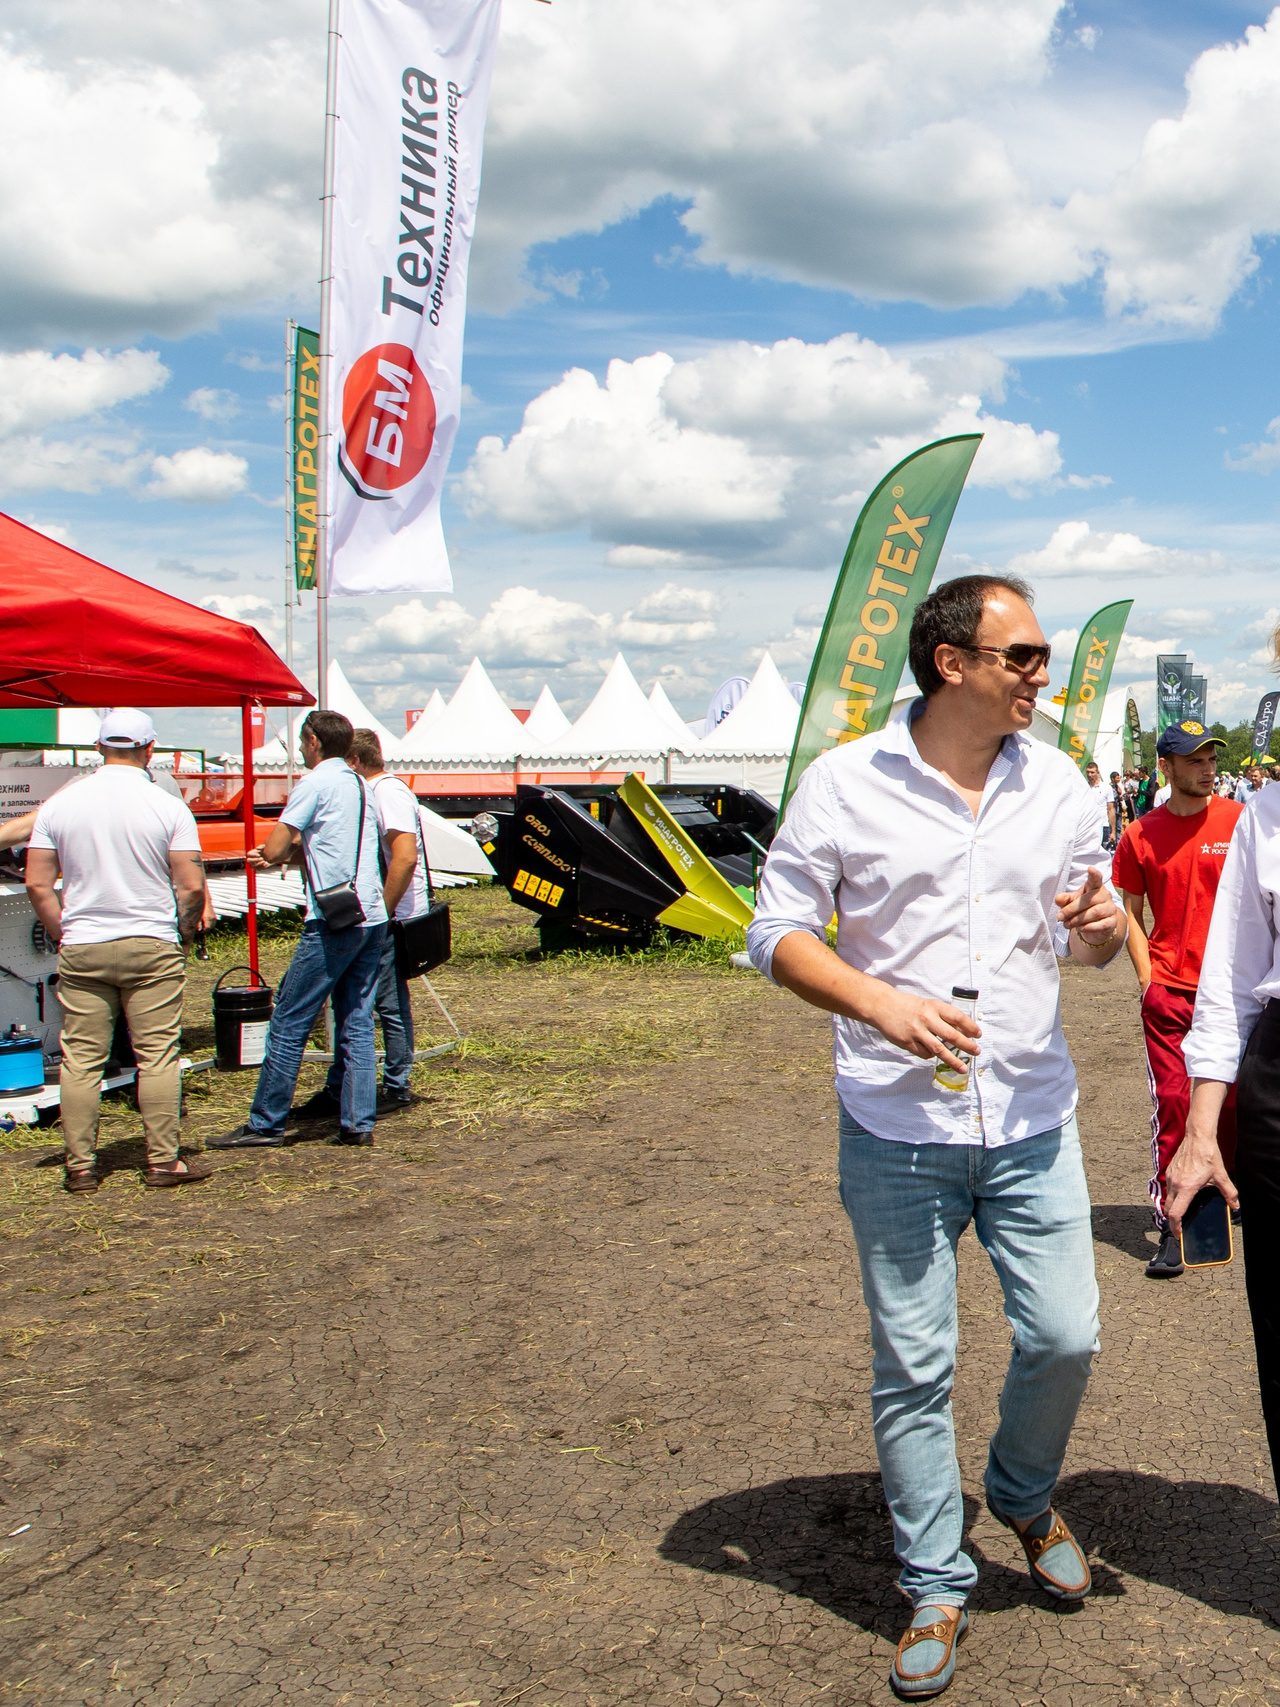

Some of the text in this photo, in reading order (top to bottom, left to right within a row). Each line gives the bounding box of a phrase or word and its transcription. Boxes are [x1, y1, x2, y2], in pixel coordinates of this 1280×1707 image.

[446, 80, 462, 153] дилер
[382, 66, 437, 316] Техника
[365, 357, 415, 470] БМ
[1255, 701, 1272, 747] СД-Агро
[654, 816, 696, 869] ИНАГРОТЕХ
